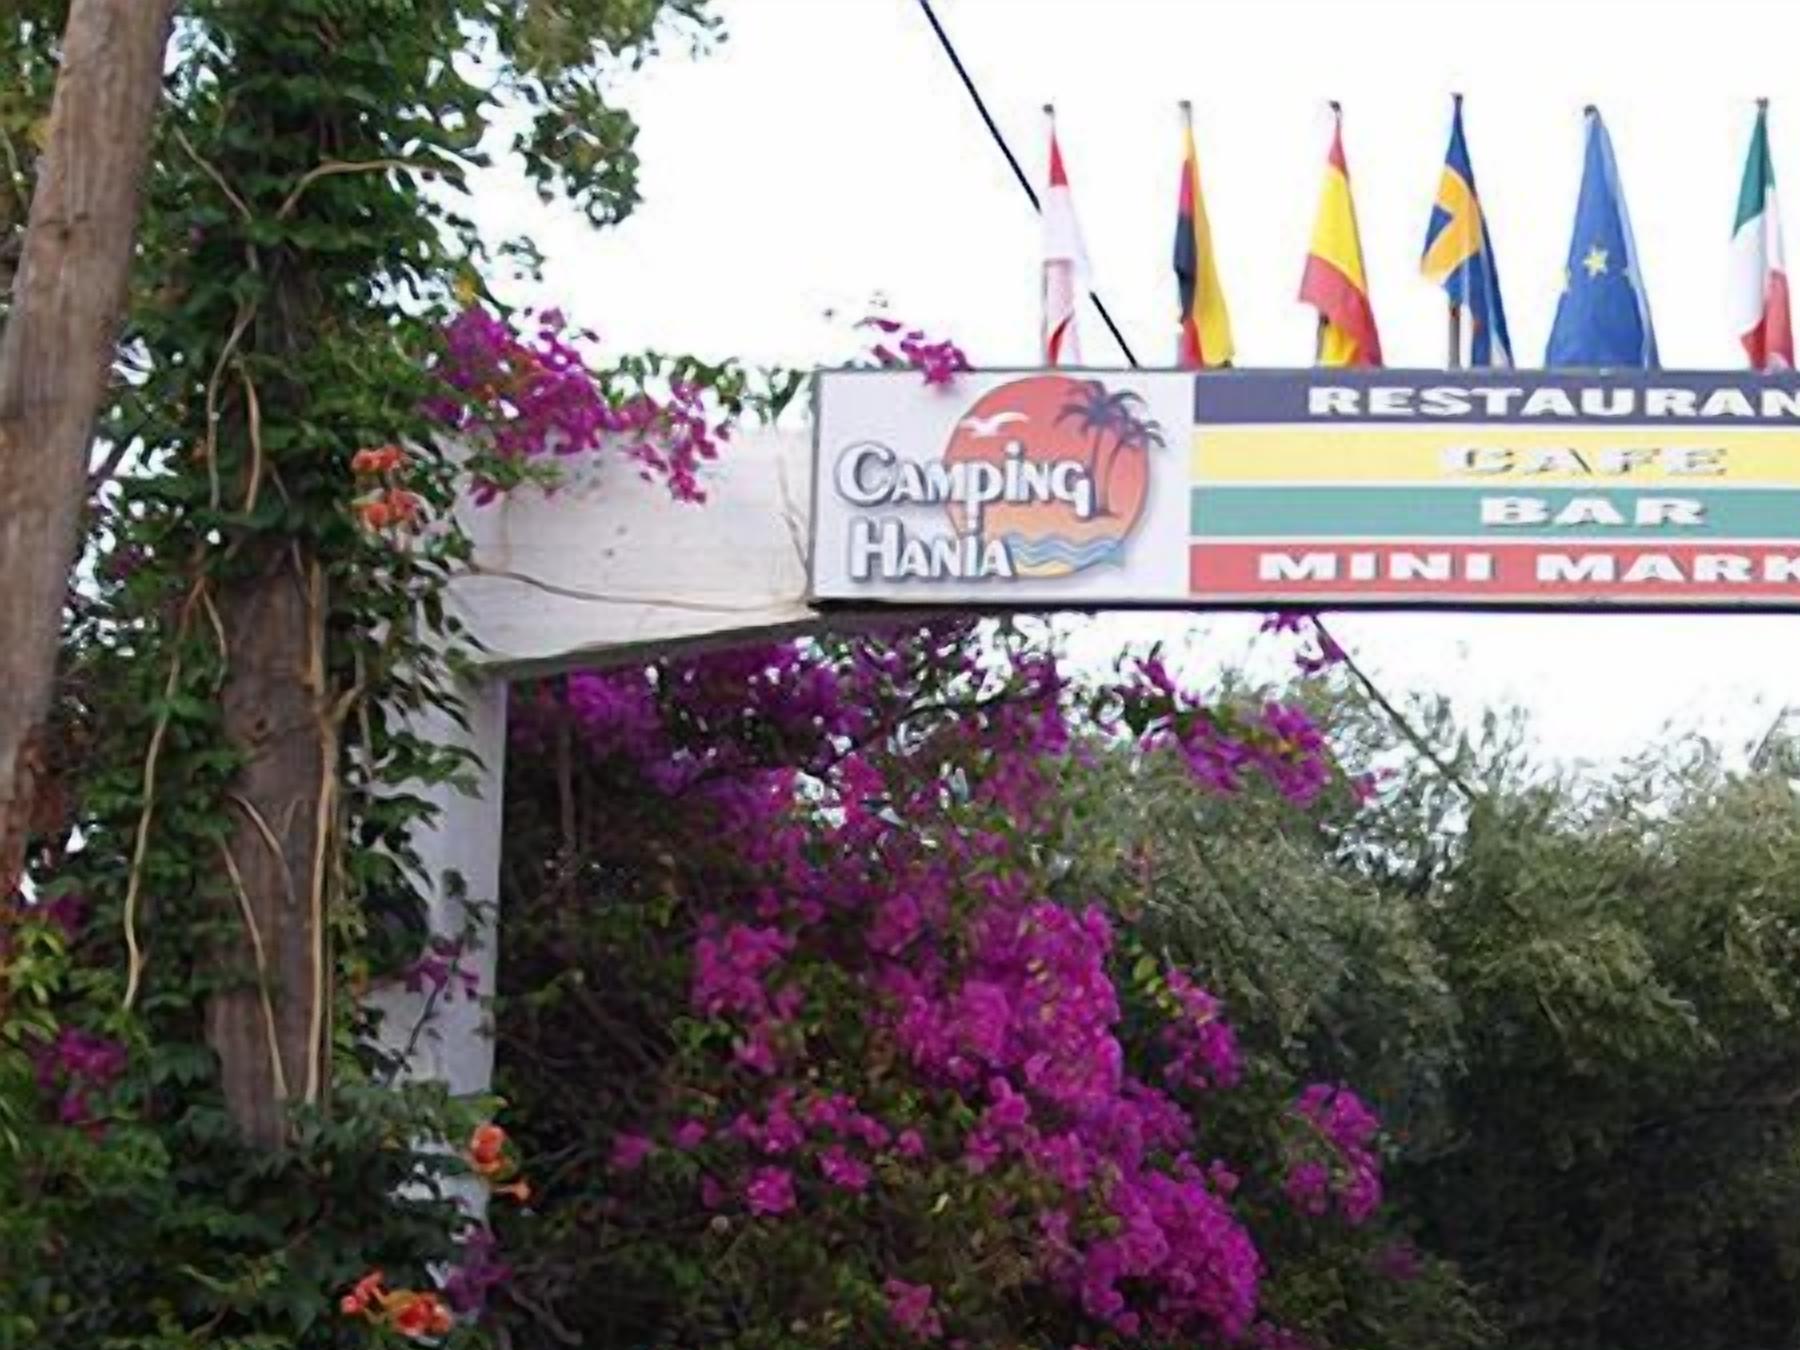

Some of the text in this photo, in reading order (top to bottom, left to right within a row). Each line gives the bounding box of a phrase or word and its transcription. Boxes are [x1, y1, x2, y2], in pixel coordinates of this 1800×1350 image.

[1441, 446, 1729, 477] CAFE
[1480, 495, 1709, 527] BAR
[1257, 551, 1496, 584] MINI
